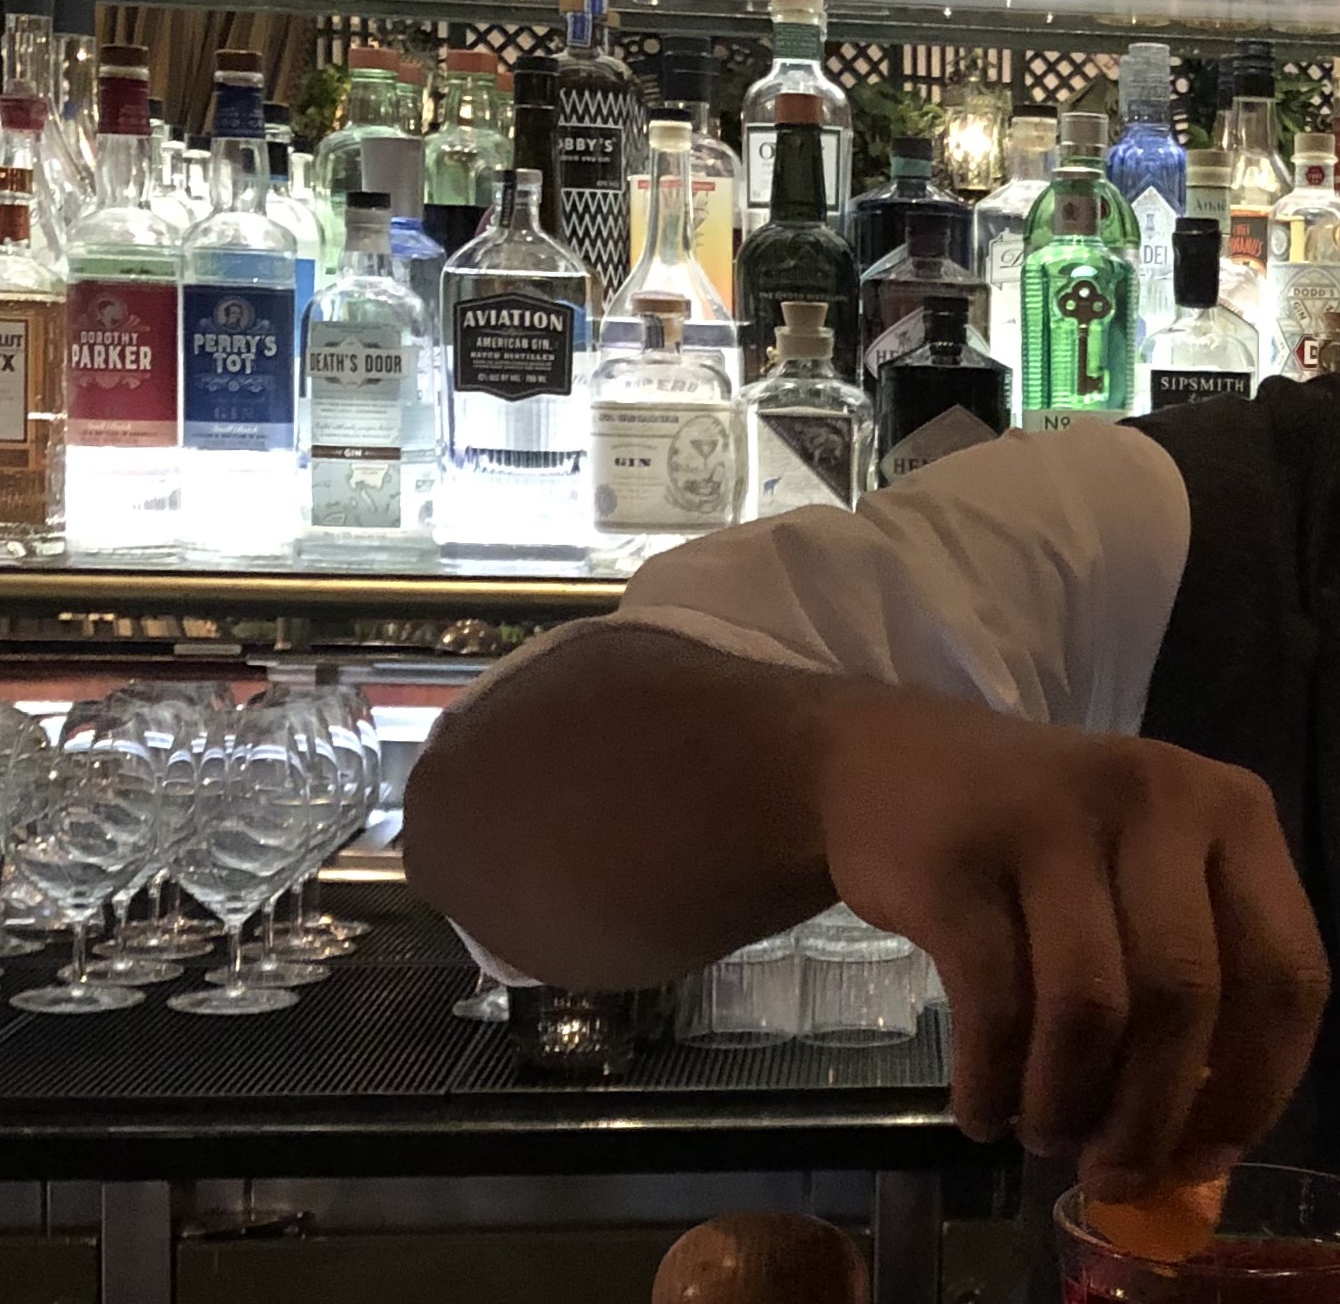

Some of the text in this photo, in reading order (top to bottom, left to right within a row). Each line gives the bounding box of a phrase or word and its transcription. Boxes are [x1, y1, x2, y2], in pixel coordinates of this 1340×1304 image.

[463, 308, 563, 333] AVIATION
[80, 331, 139, 346] DOROTHY
[193, 333, 278, 357] PERRY'S
[476, 336, 529, 350] AMERICAN
[71, 344, 152, 371] PARKER
[213, 352, 256, 374] TOT
[309, 352, 402, 374] DEATH'S DOOR
[1160, 376, 1245, 392] SIPSMITH
[343, 448, 363, 458] GIN
[614, 457, 652, 467] GIN
